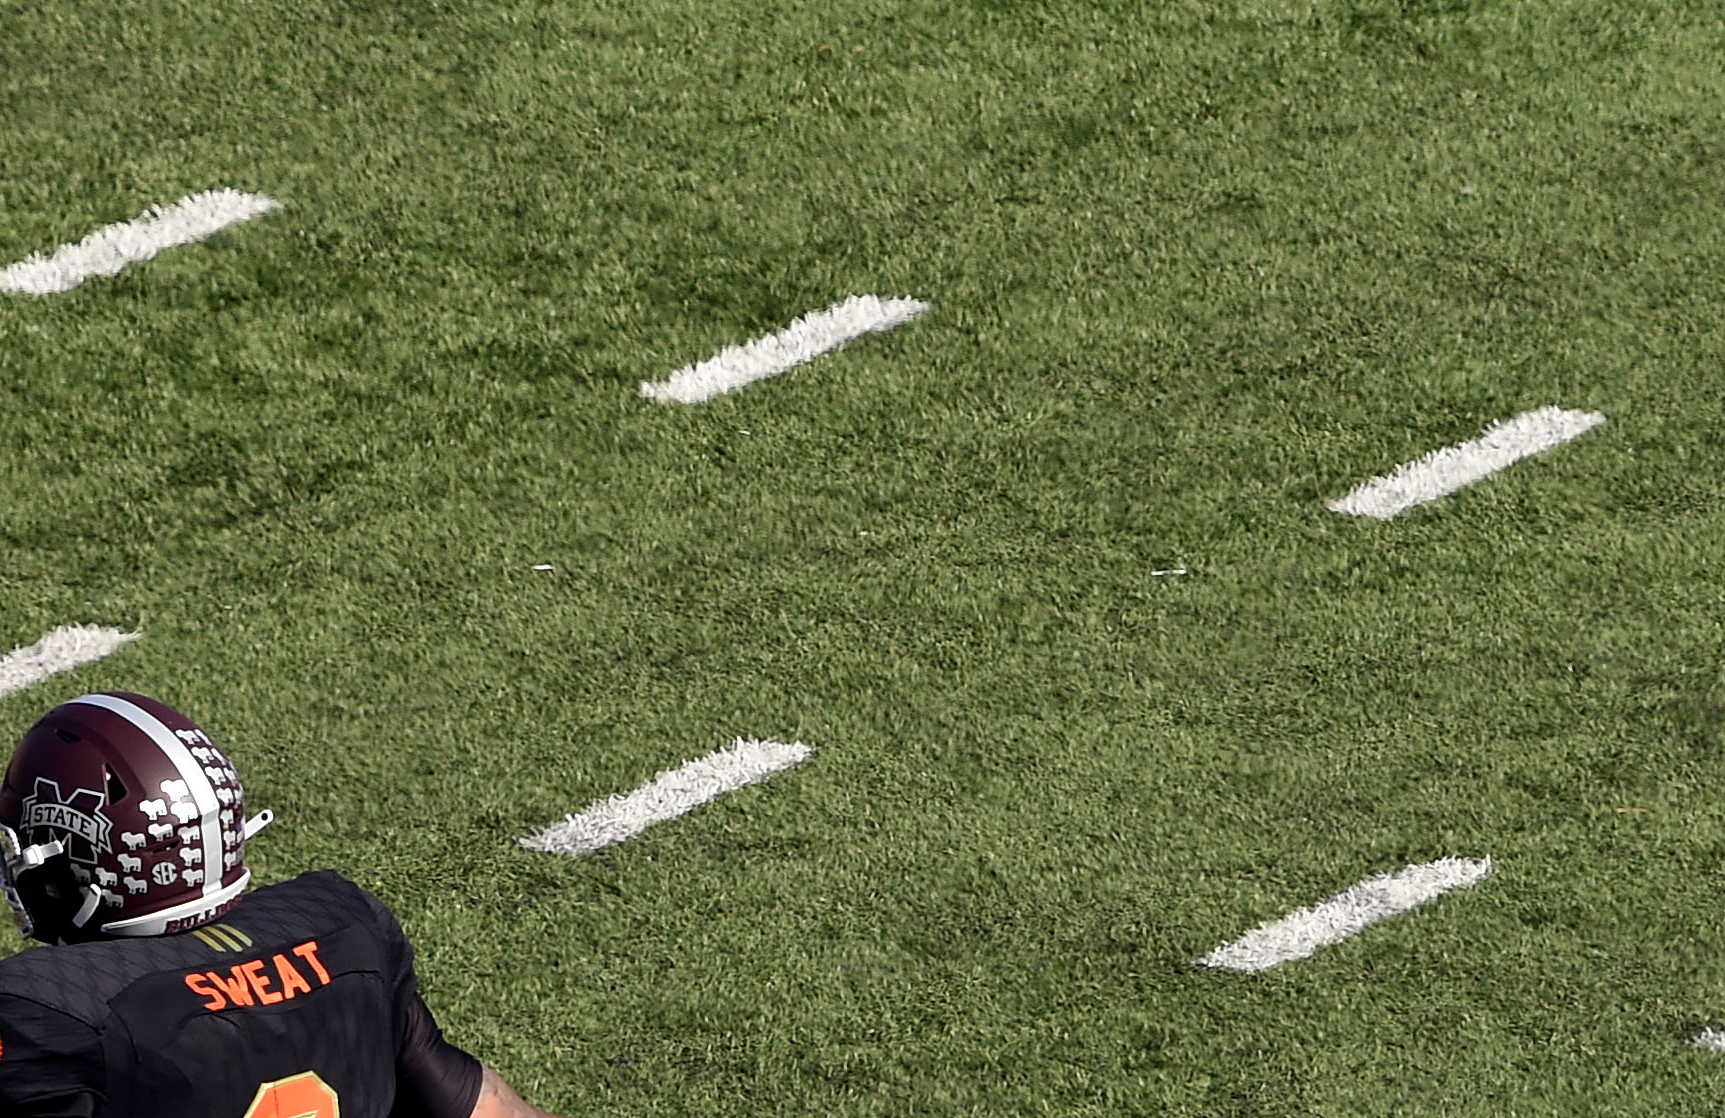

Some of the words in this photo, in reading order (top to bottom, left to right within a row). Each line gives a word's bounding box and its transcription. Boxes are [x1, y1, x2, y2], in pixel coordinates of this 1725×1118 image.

[34, 806, 92, 837] STATE
[152, 861, 178, 886] SEC
[185, 941, 331, 1011] SWEAT
